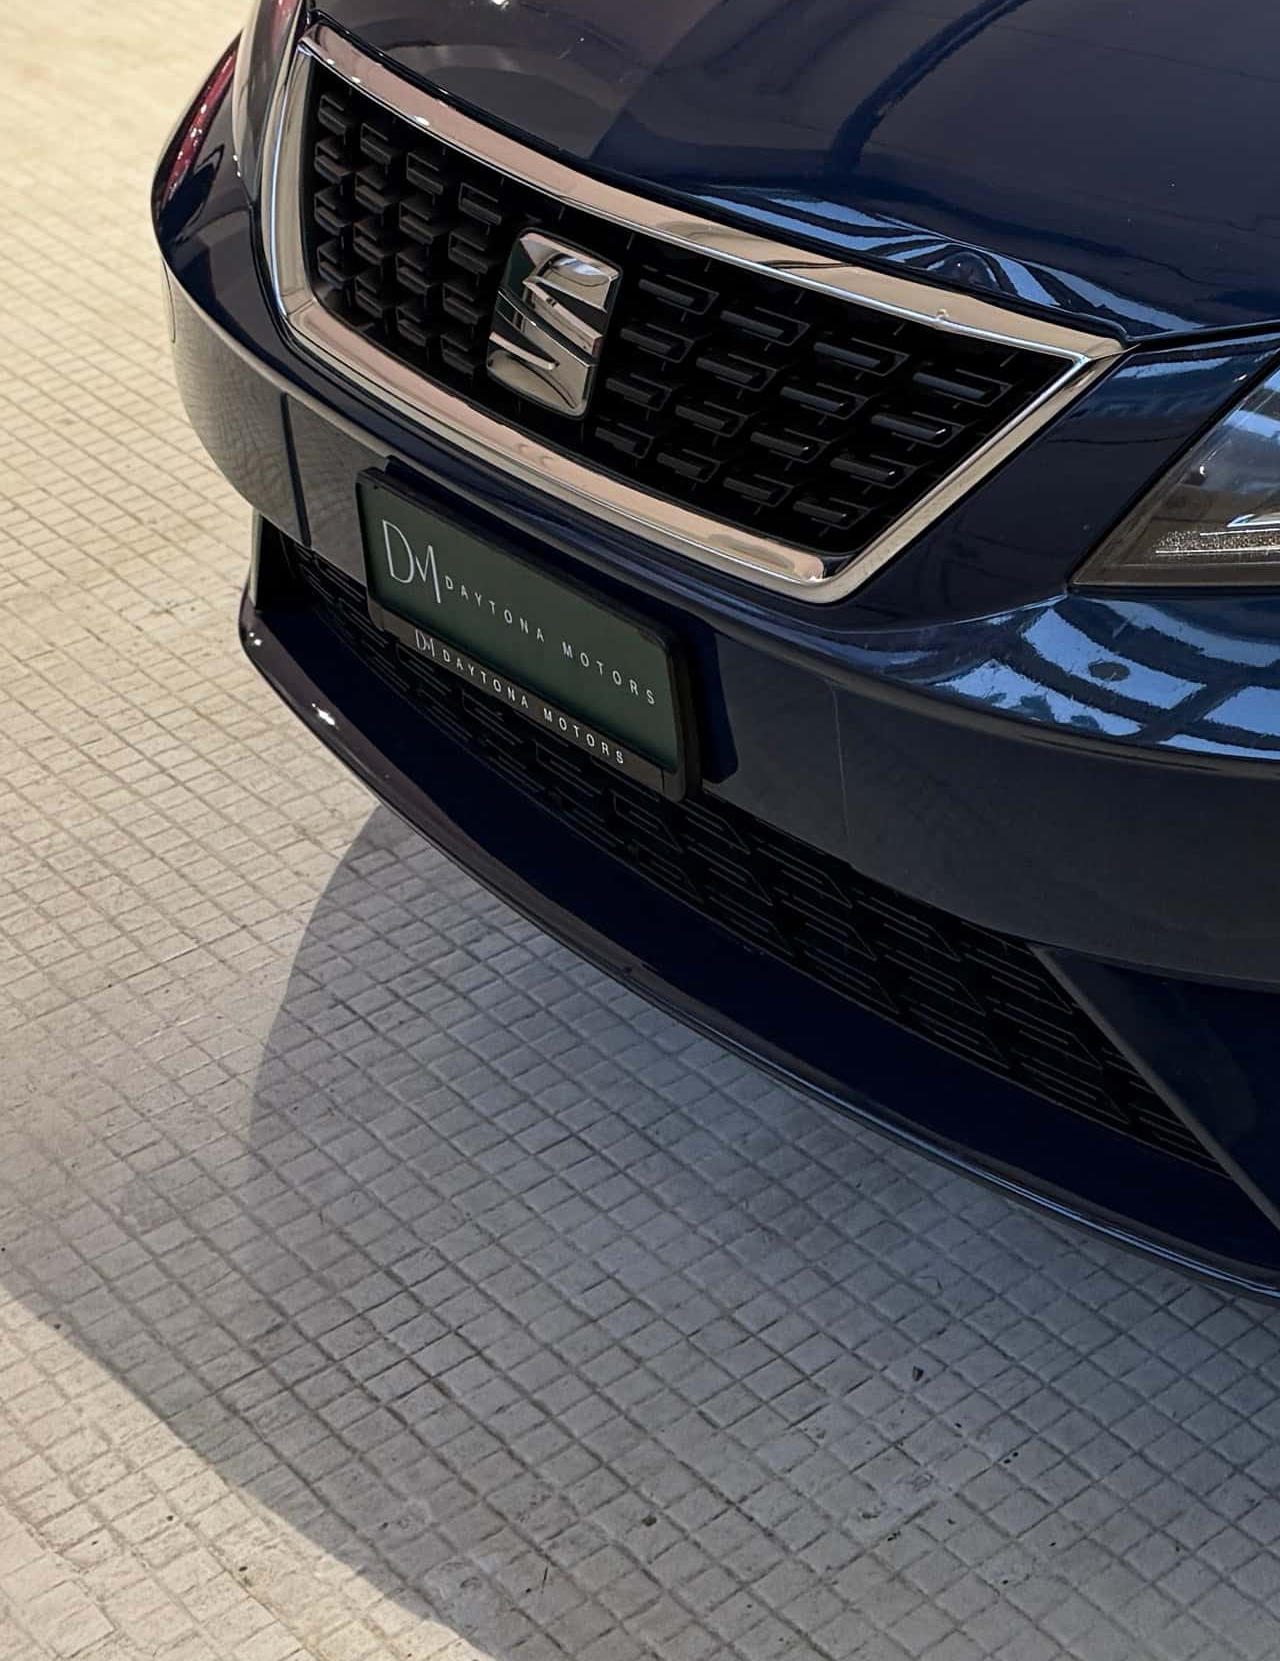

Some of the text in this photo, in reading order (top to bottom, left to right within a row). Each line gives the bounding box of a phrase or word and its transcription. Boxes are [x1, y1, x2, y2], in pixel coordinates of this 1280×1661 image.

[445, 574, 656, 706] DAYTONA MOTORS
[442, 648, 625, 765] DAYTONA MOTORS
